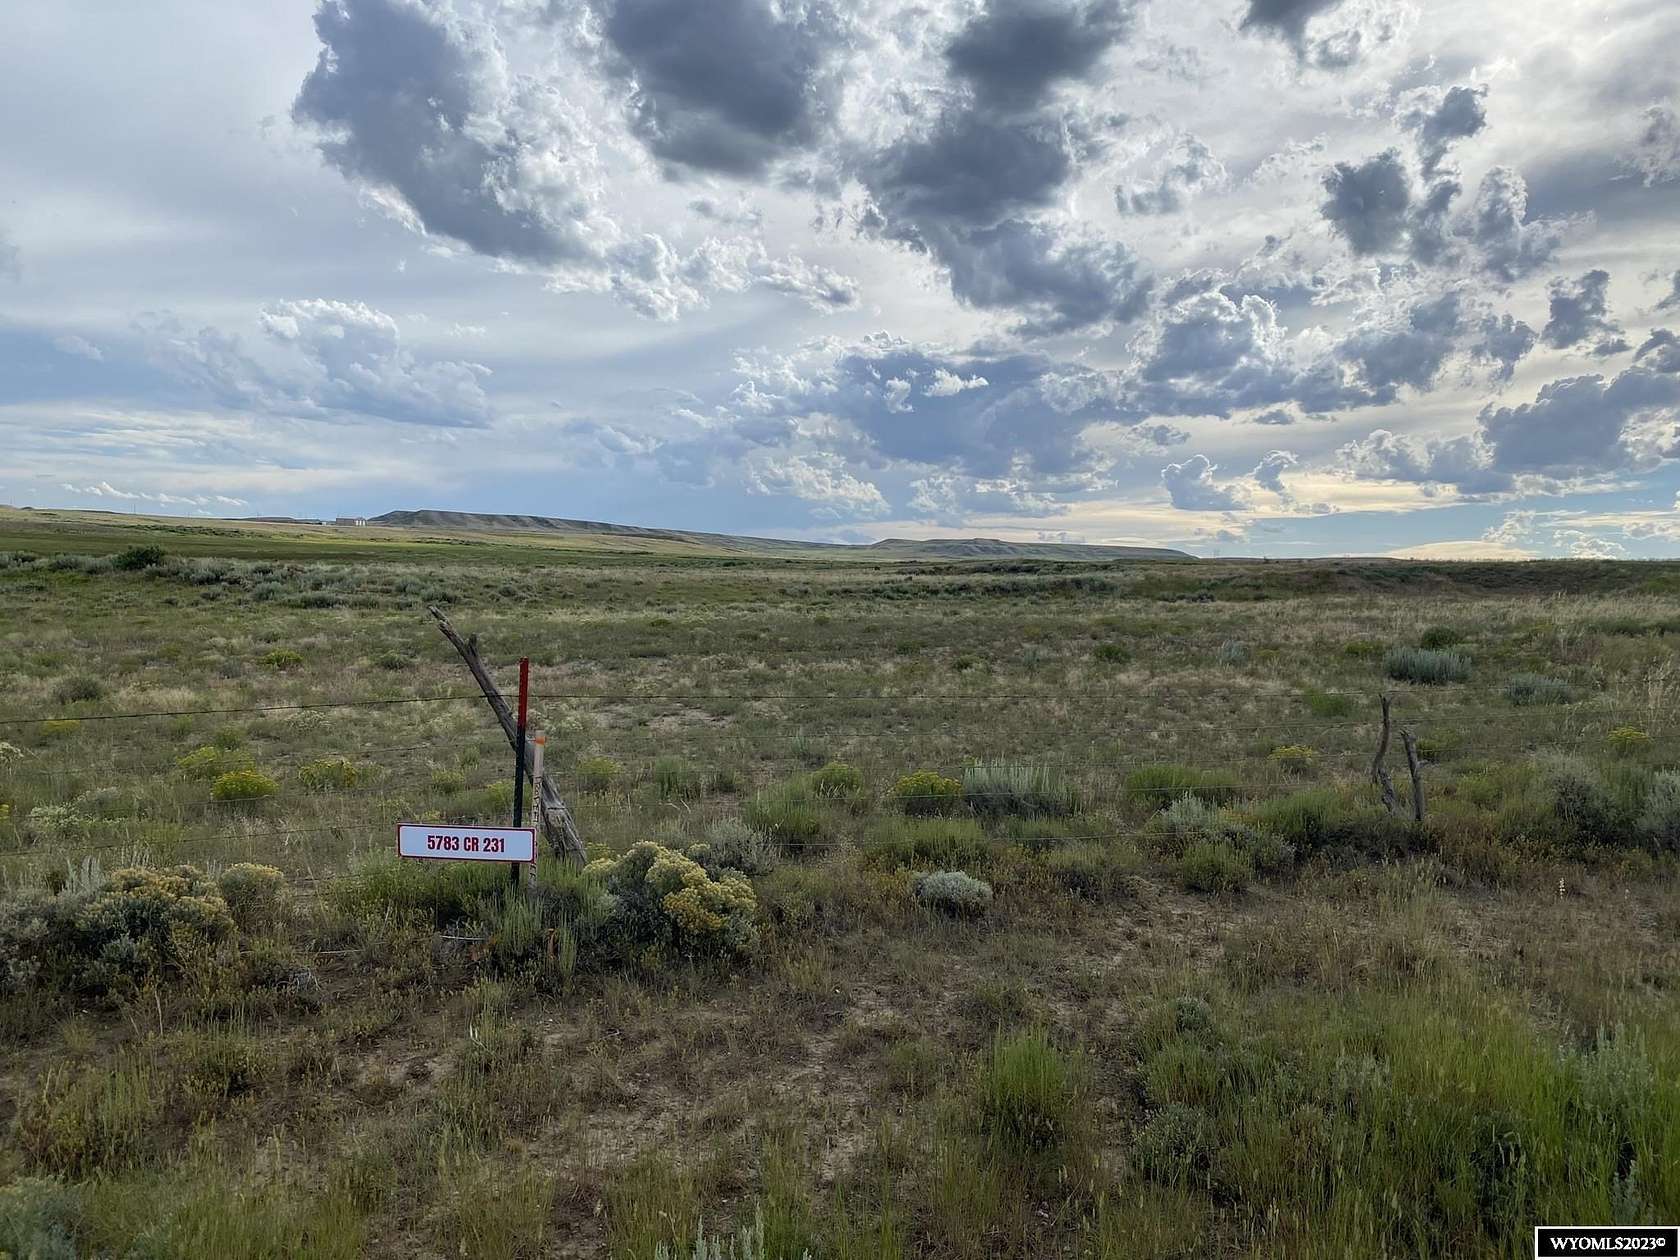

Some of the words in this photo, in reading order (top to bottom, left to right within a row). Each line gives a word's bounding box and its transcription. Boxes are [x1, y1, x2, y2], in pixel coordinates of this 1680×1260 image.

[427, 835, 460, 851] 5783
[463, 836, 480, 852] CR
[483, 837, 506, 853] 231
